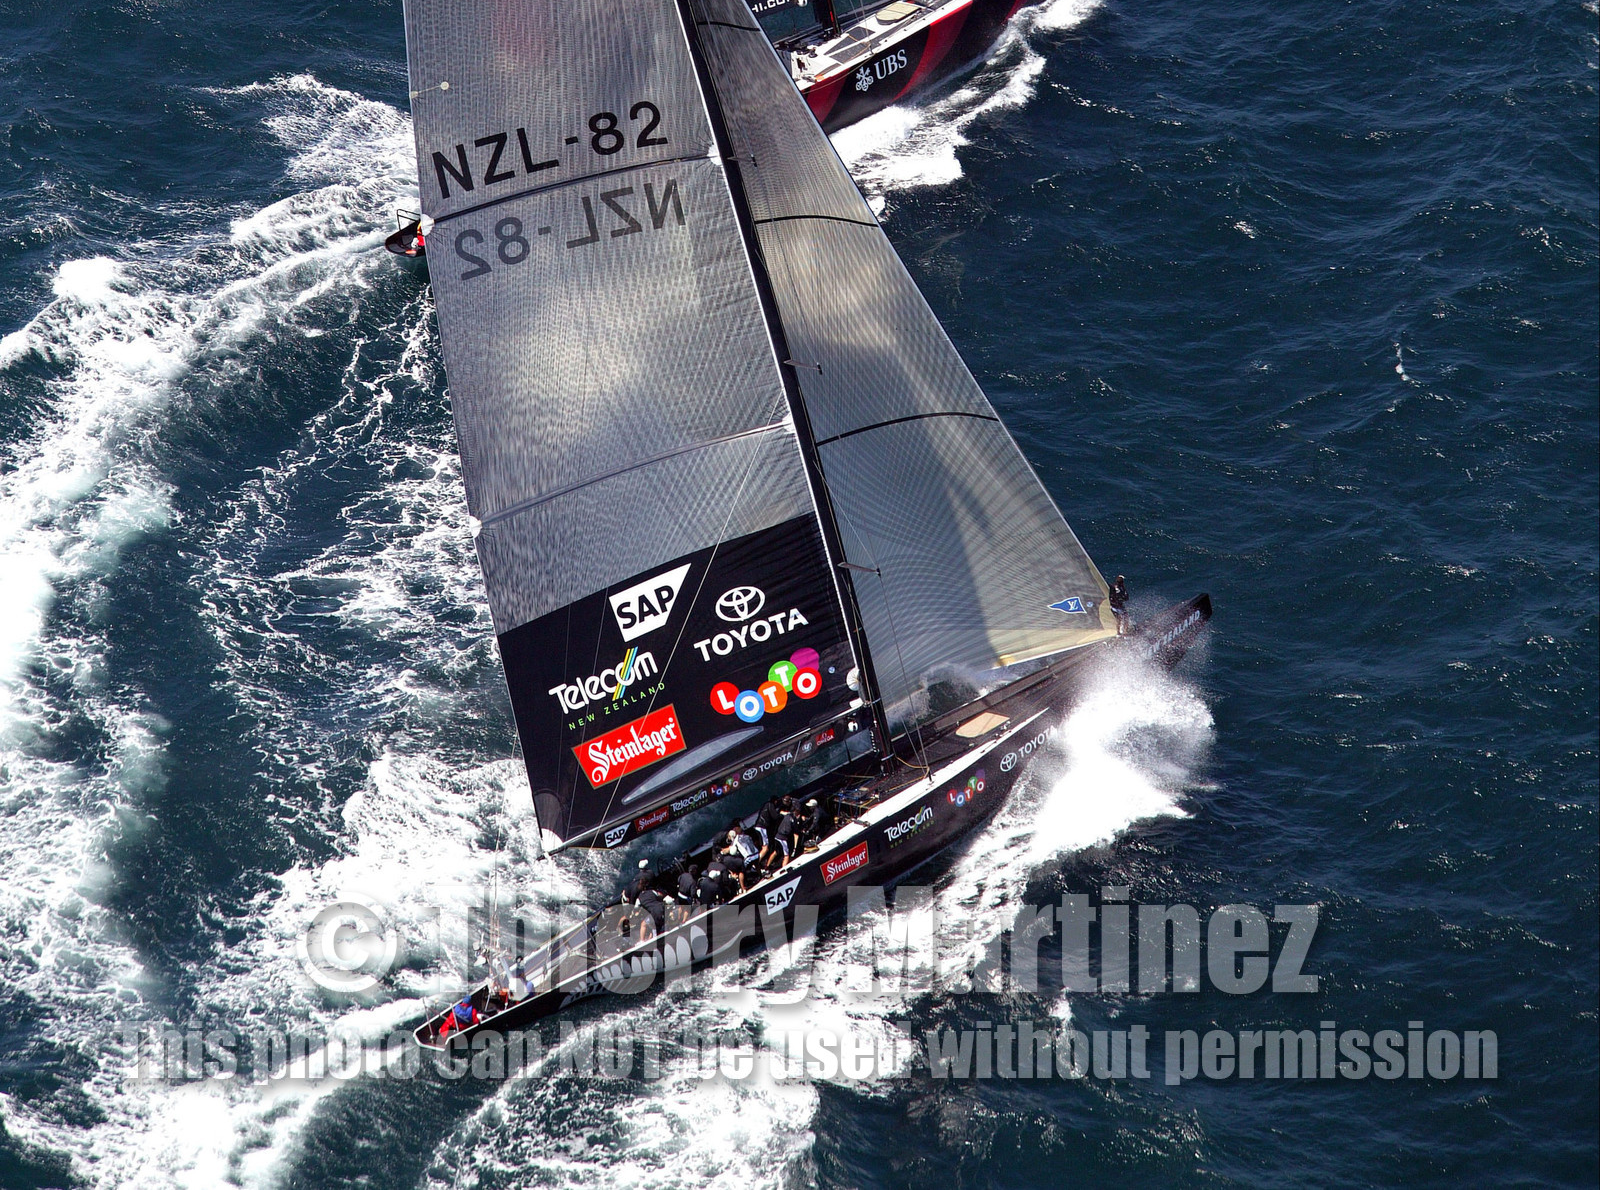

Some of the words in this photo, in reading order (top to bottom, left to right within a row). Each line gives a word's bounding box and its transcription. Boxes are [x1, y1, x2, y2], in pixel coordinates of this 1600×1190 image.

[874, 49, 908, 80] UBS
[616, 584, 675, 630] SAP
[693, 608, 810, 662] TOYOTA
[548, 648, 659, 715] Telecom
[714, 665, 819, 721] LOTTO
[568, 713, 596, 731] NEW
[604, 682, 666, 716] ZEALAND
[588, 716, 678, 785] Steinlager
[758, 752, 794, 774] TOYOTA
[710, 777, 739, 796] LOTTO
[949, 778, 985, 805] LOTTO
[605, 828, 626, 845] SAP
[883, 805, 933, 842] Telecom
[825, 847, 867, 883] Steinlager
[766, 886, 795, 909] SAP
